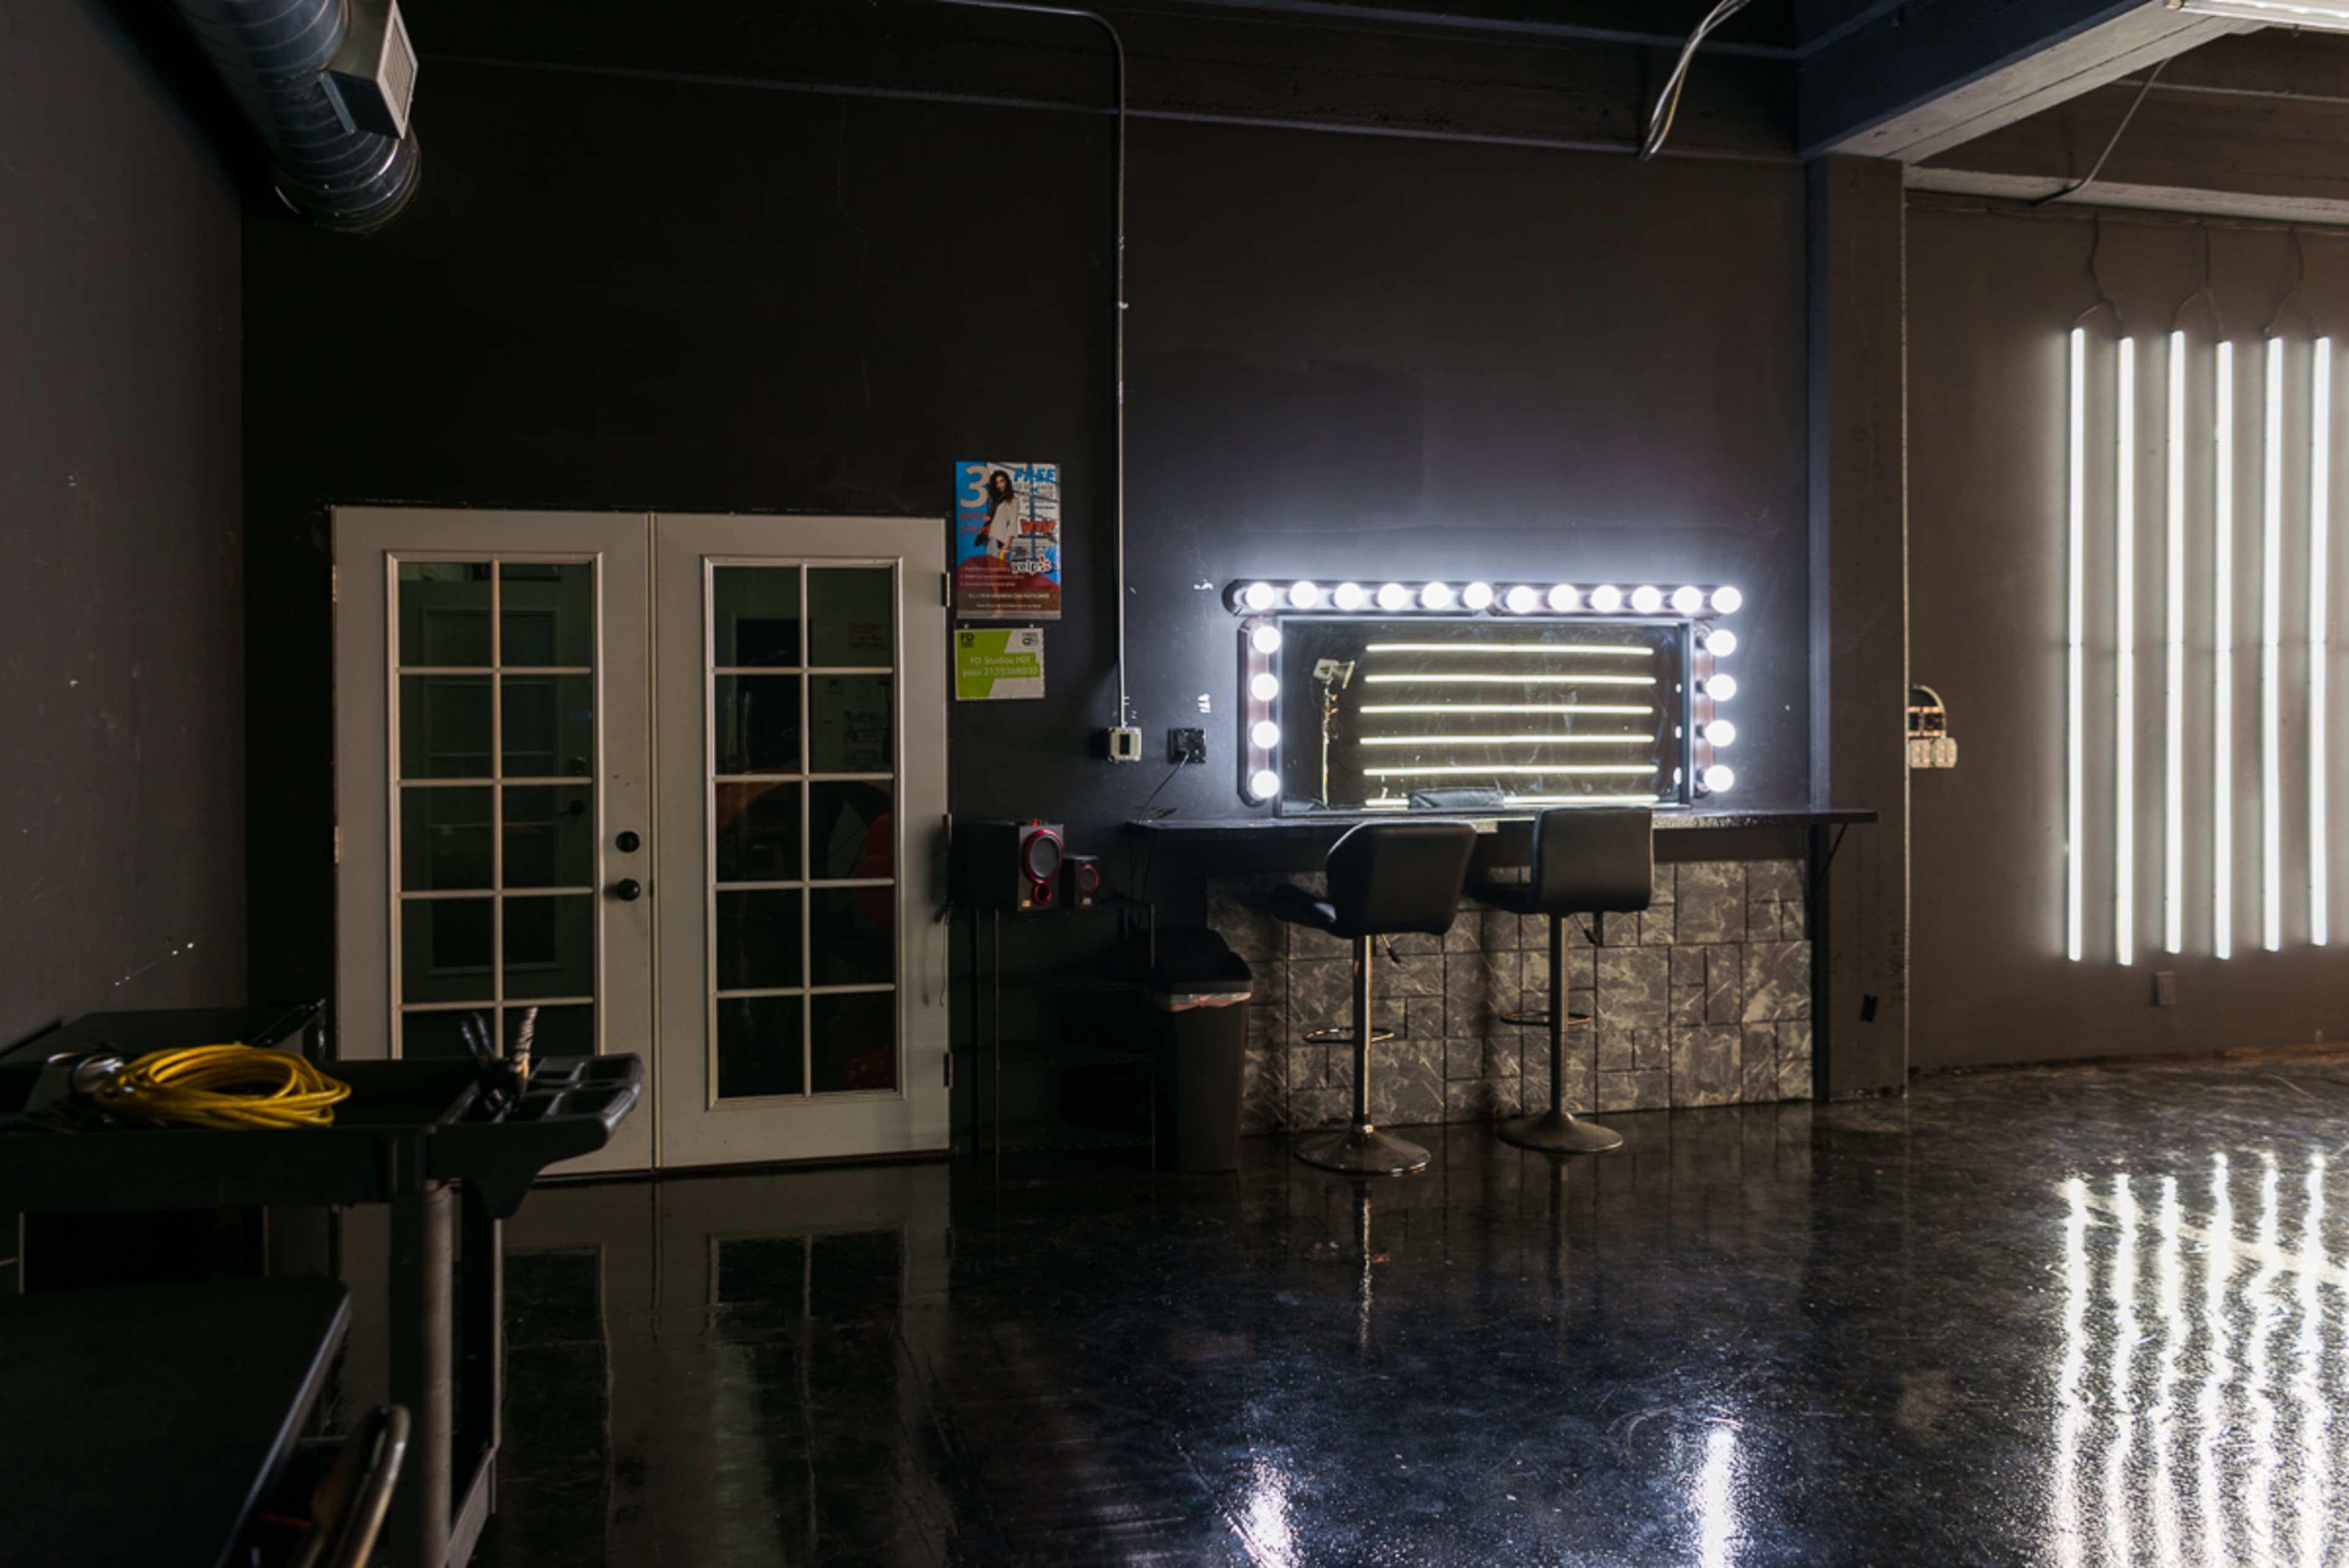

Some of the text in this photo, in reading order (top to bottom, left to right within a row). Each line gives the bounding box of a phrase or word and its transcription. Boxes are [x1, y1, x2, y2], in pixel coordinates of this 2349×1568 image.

[1014, 468, 1056, 483] FREE
[960, 465, 990, 508] 3
[1020, 518, 1056, 534] WIN!
[1012, 561, 1038, 575] yelp
